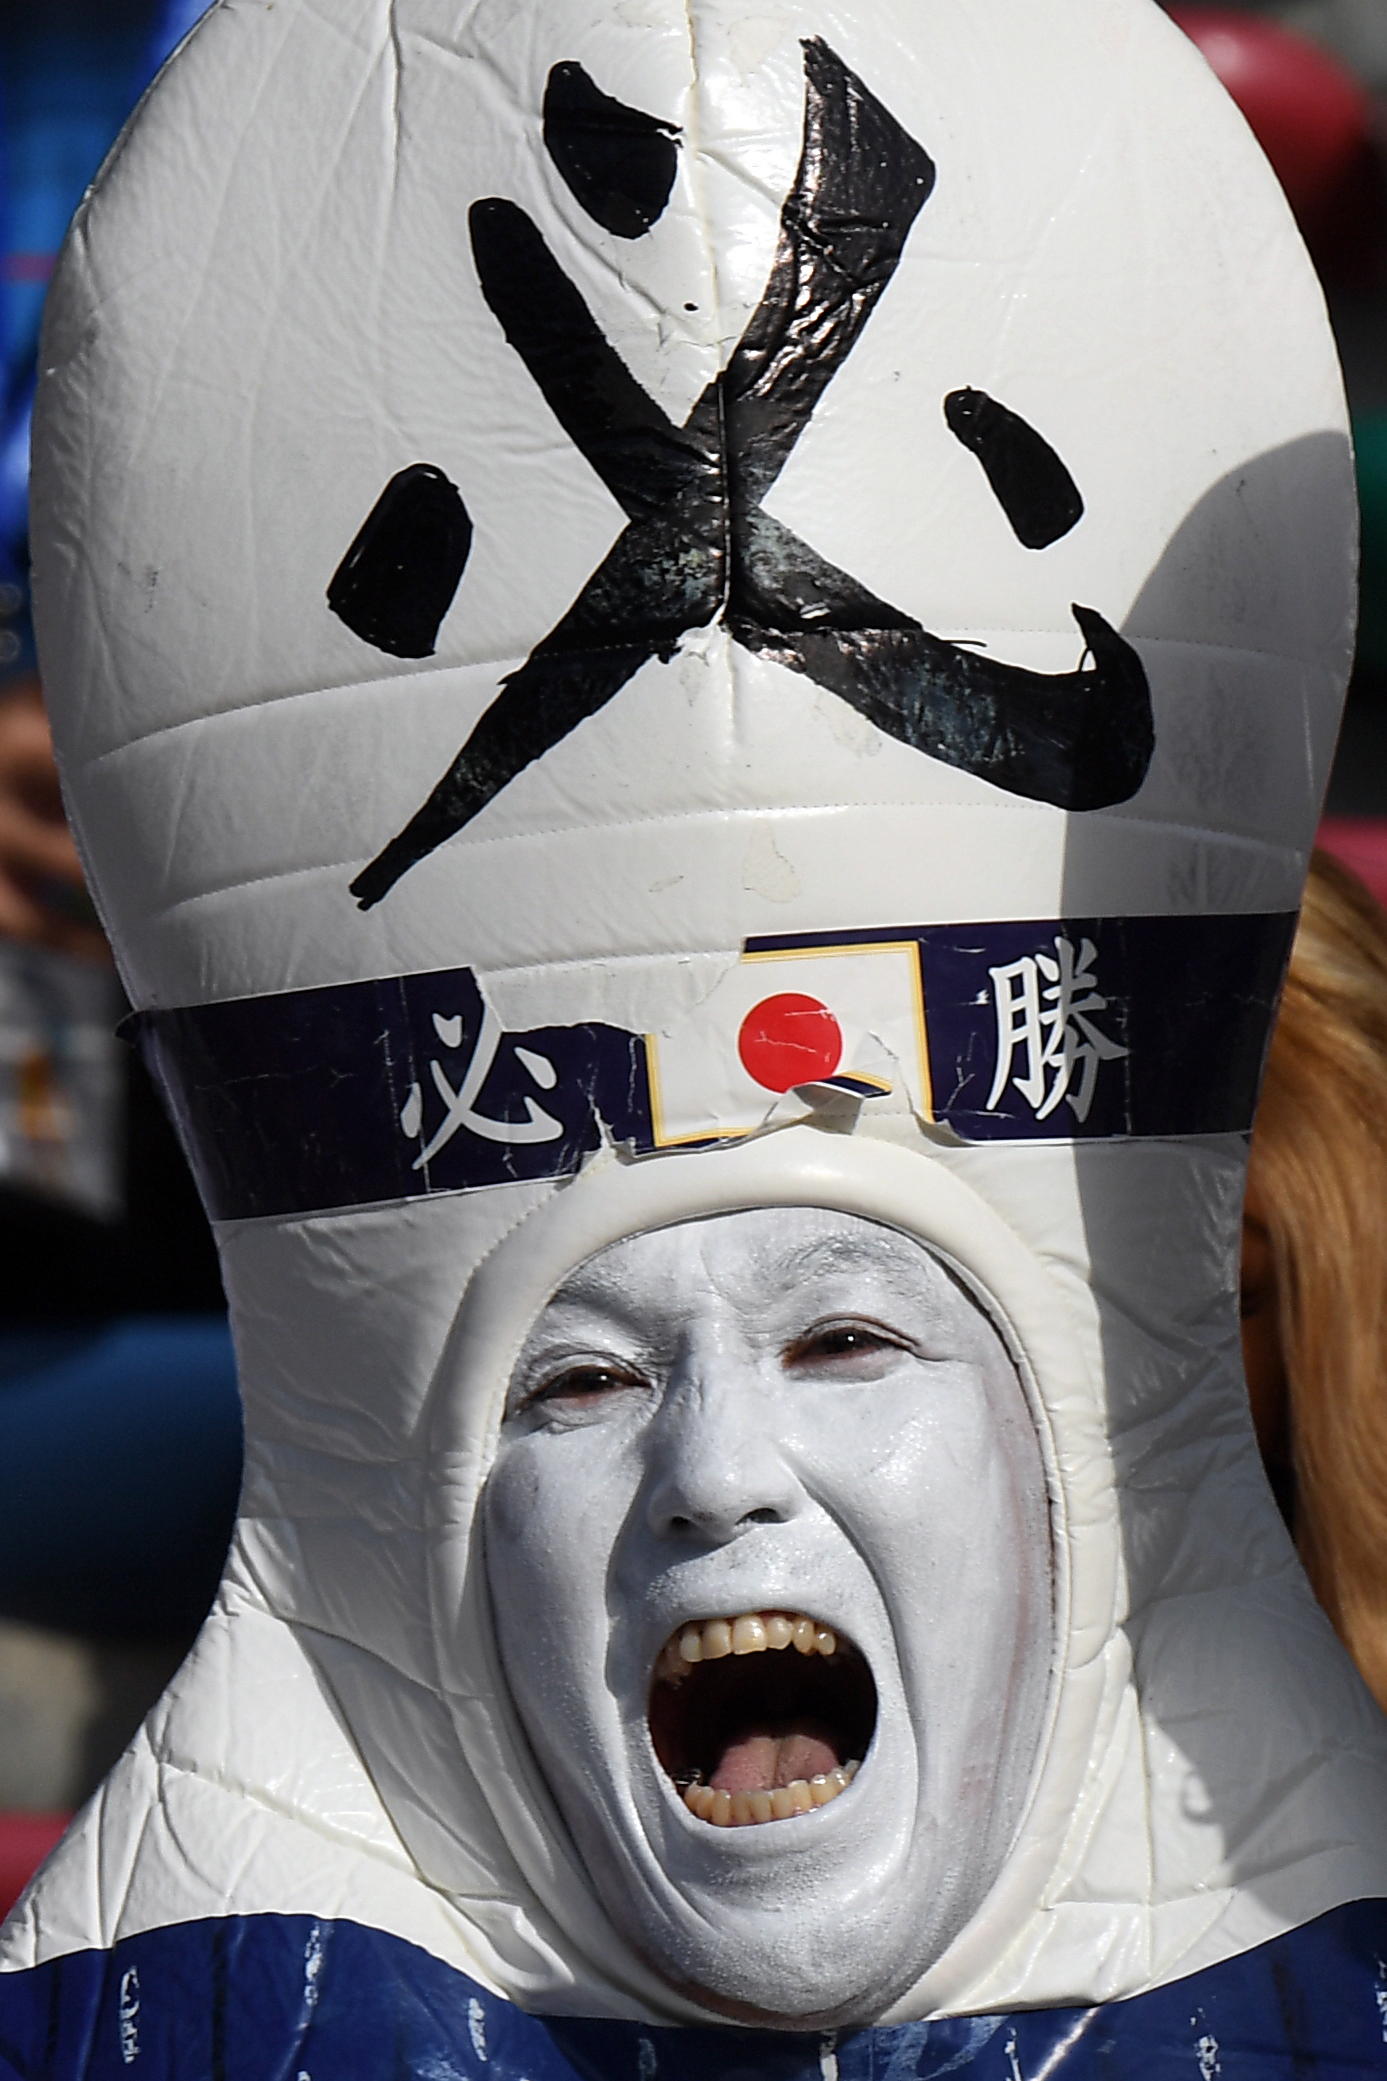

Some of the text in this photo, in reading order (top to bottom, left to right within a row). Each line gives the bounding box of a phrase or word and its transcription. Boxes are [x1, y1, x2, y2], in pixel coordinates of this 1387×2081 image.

[327, 34, 1155, 911] 必
[400, 935, 1130, 1170] 必 勝
